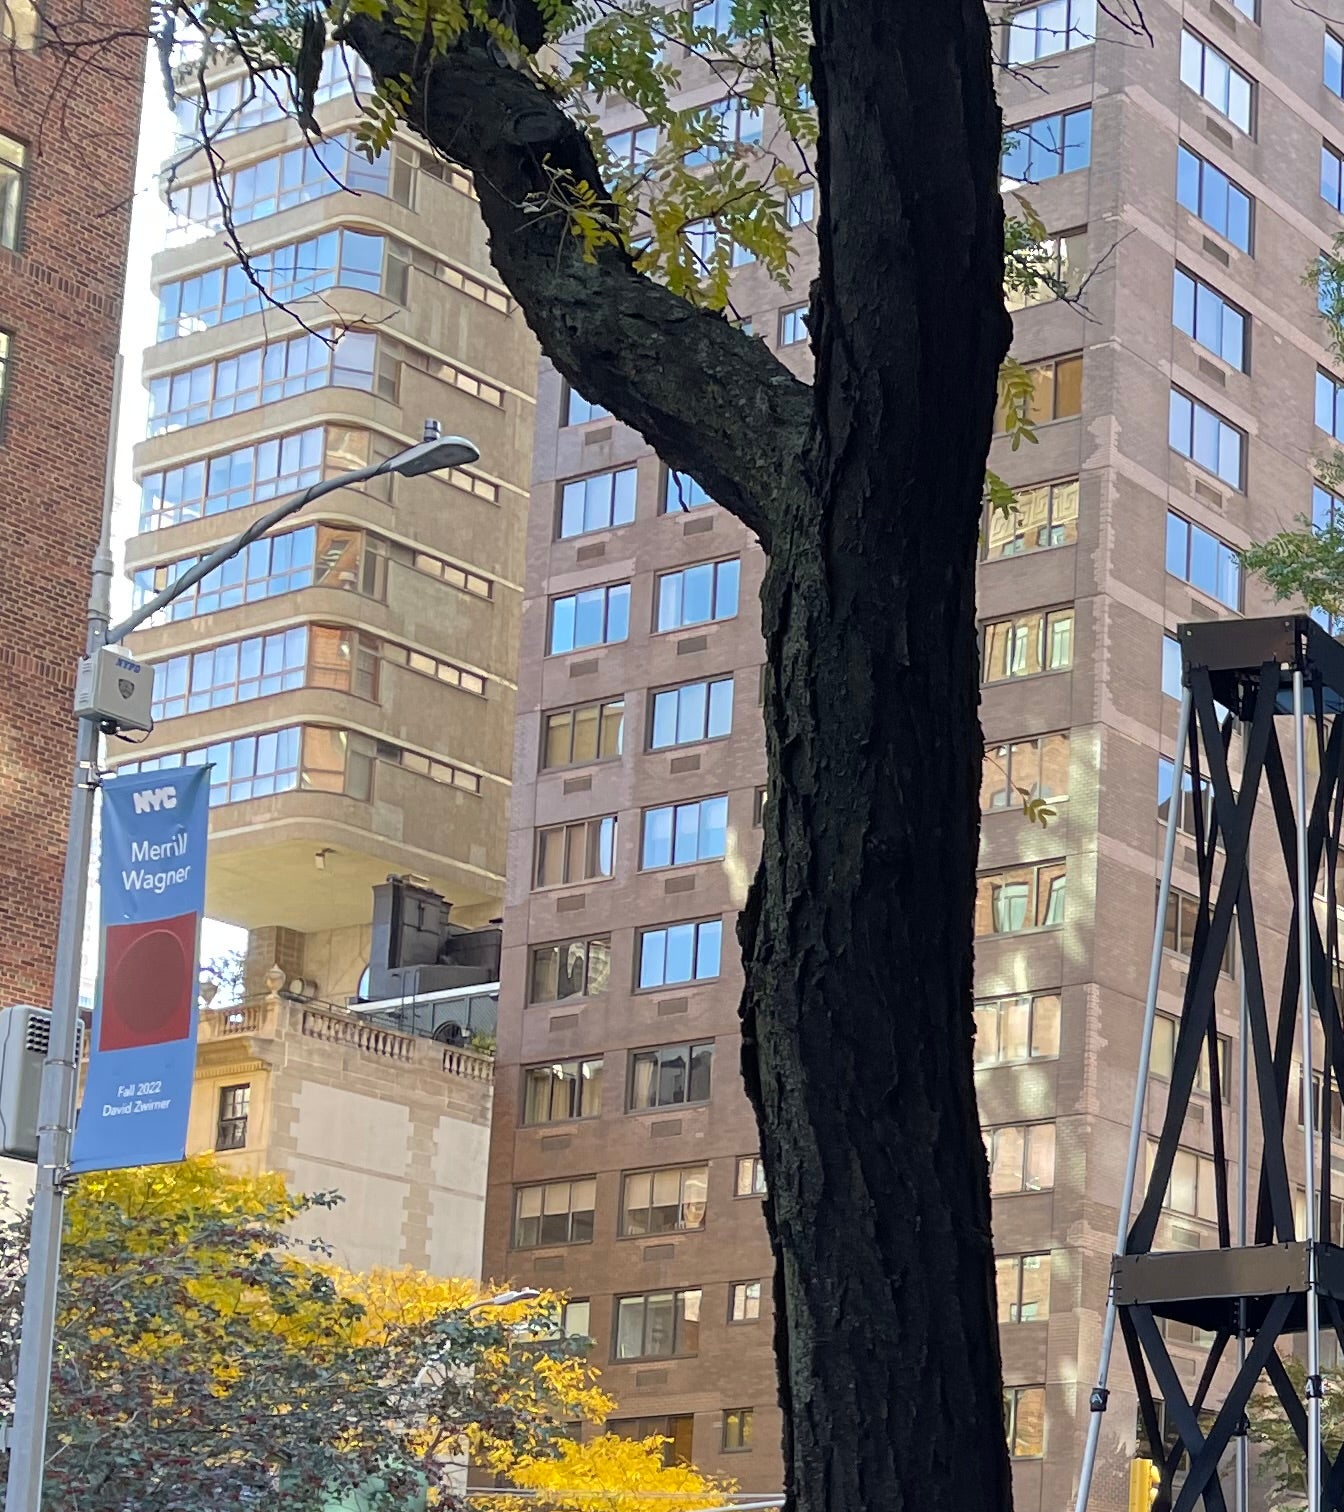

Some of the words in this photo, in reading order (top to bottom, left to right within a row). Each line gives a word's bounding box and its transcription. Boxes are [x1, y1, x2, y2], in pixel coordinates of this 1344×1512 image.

[133, 786, 177, 814] NYC
[131, 832, 188, 862] Merrill
[121, 865, 191, 894] Wagner
[117, 1083, 135, 1098] Fall
[137, 1080, 162, 1096] 2022
[102, 1101, 132, 1117] David
[133, 1099, 171, 1113] Zwirner
